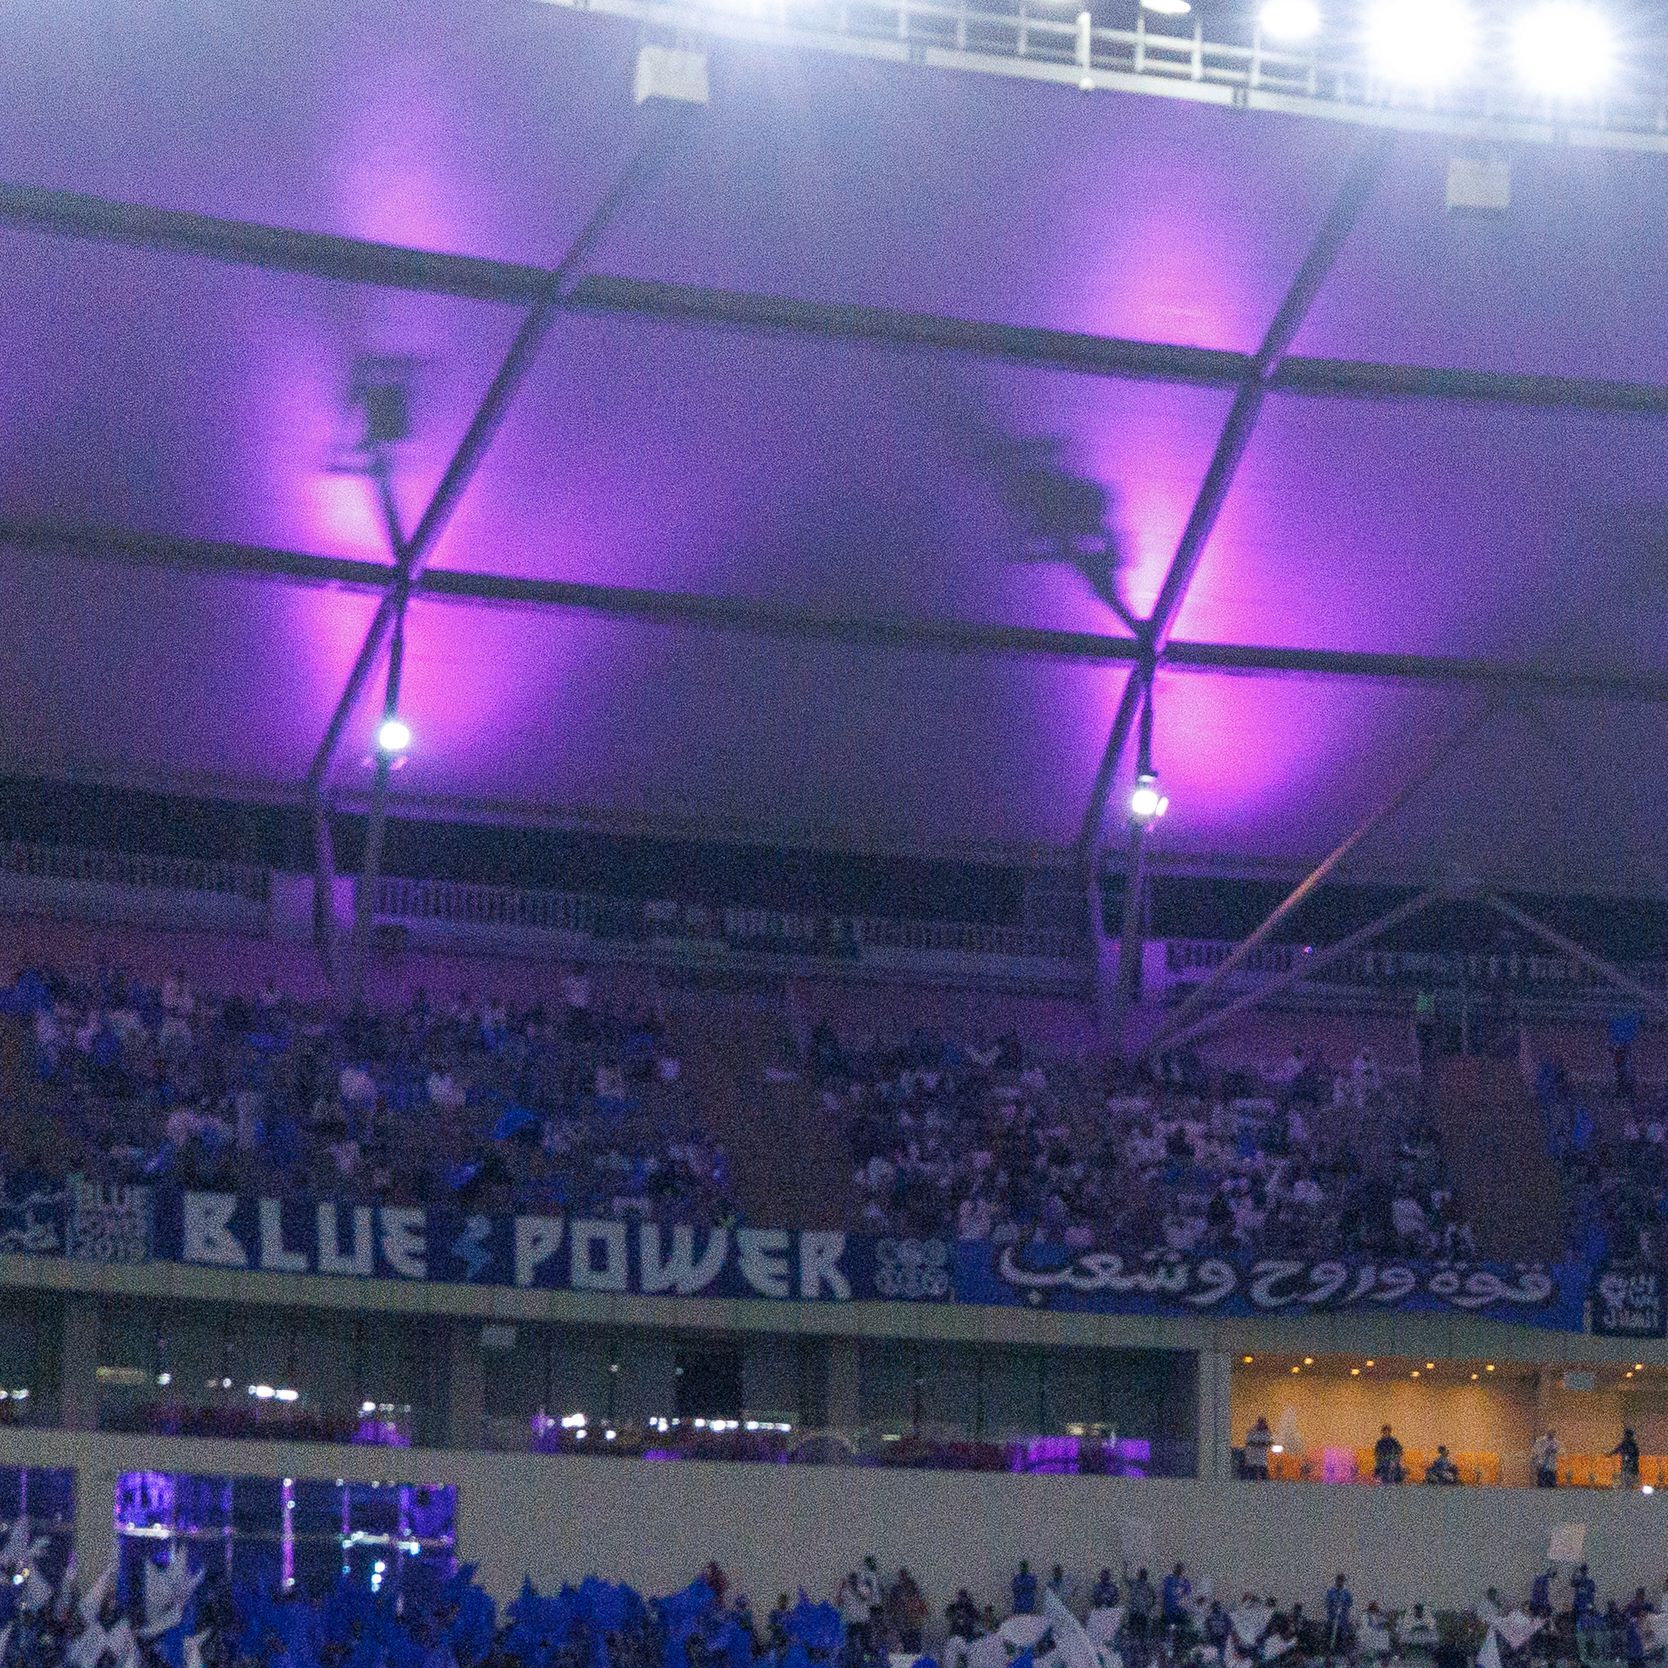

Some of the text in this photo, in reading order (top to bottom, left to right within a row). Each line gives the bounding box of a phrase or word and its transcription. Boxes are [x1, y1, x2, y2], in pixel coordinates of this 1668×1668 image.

[182, 1191, 851, 1300] BLUE POWER
[1000, 1243, 1237, 1305] وشعب
[1250, 1258, 1417, 1308] وروح
[1428, 1260, 1552, 1307] قوة
